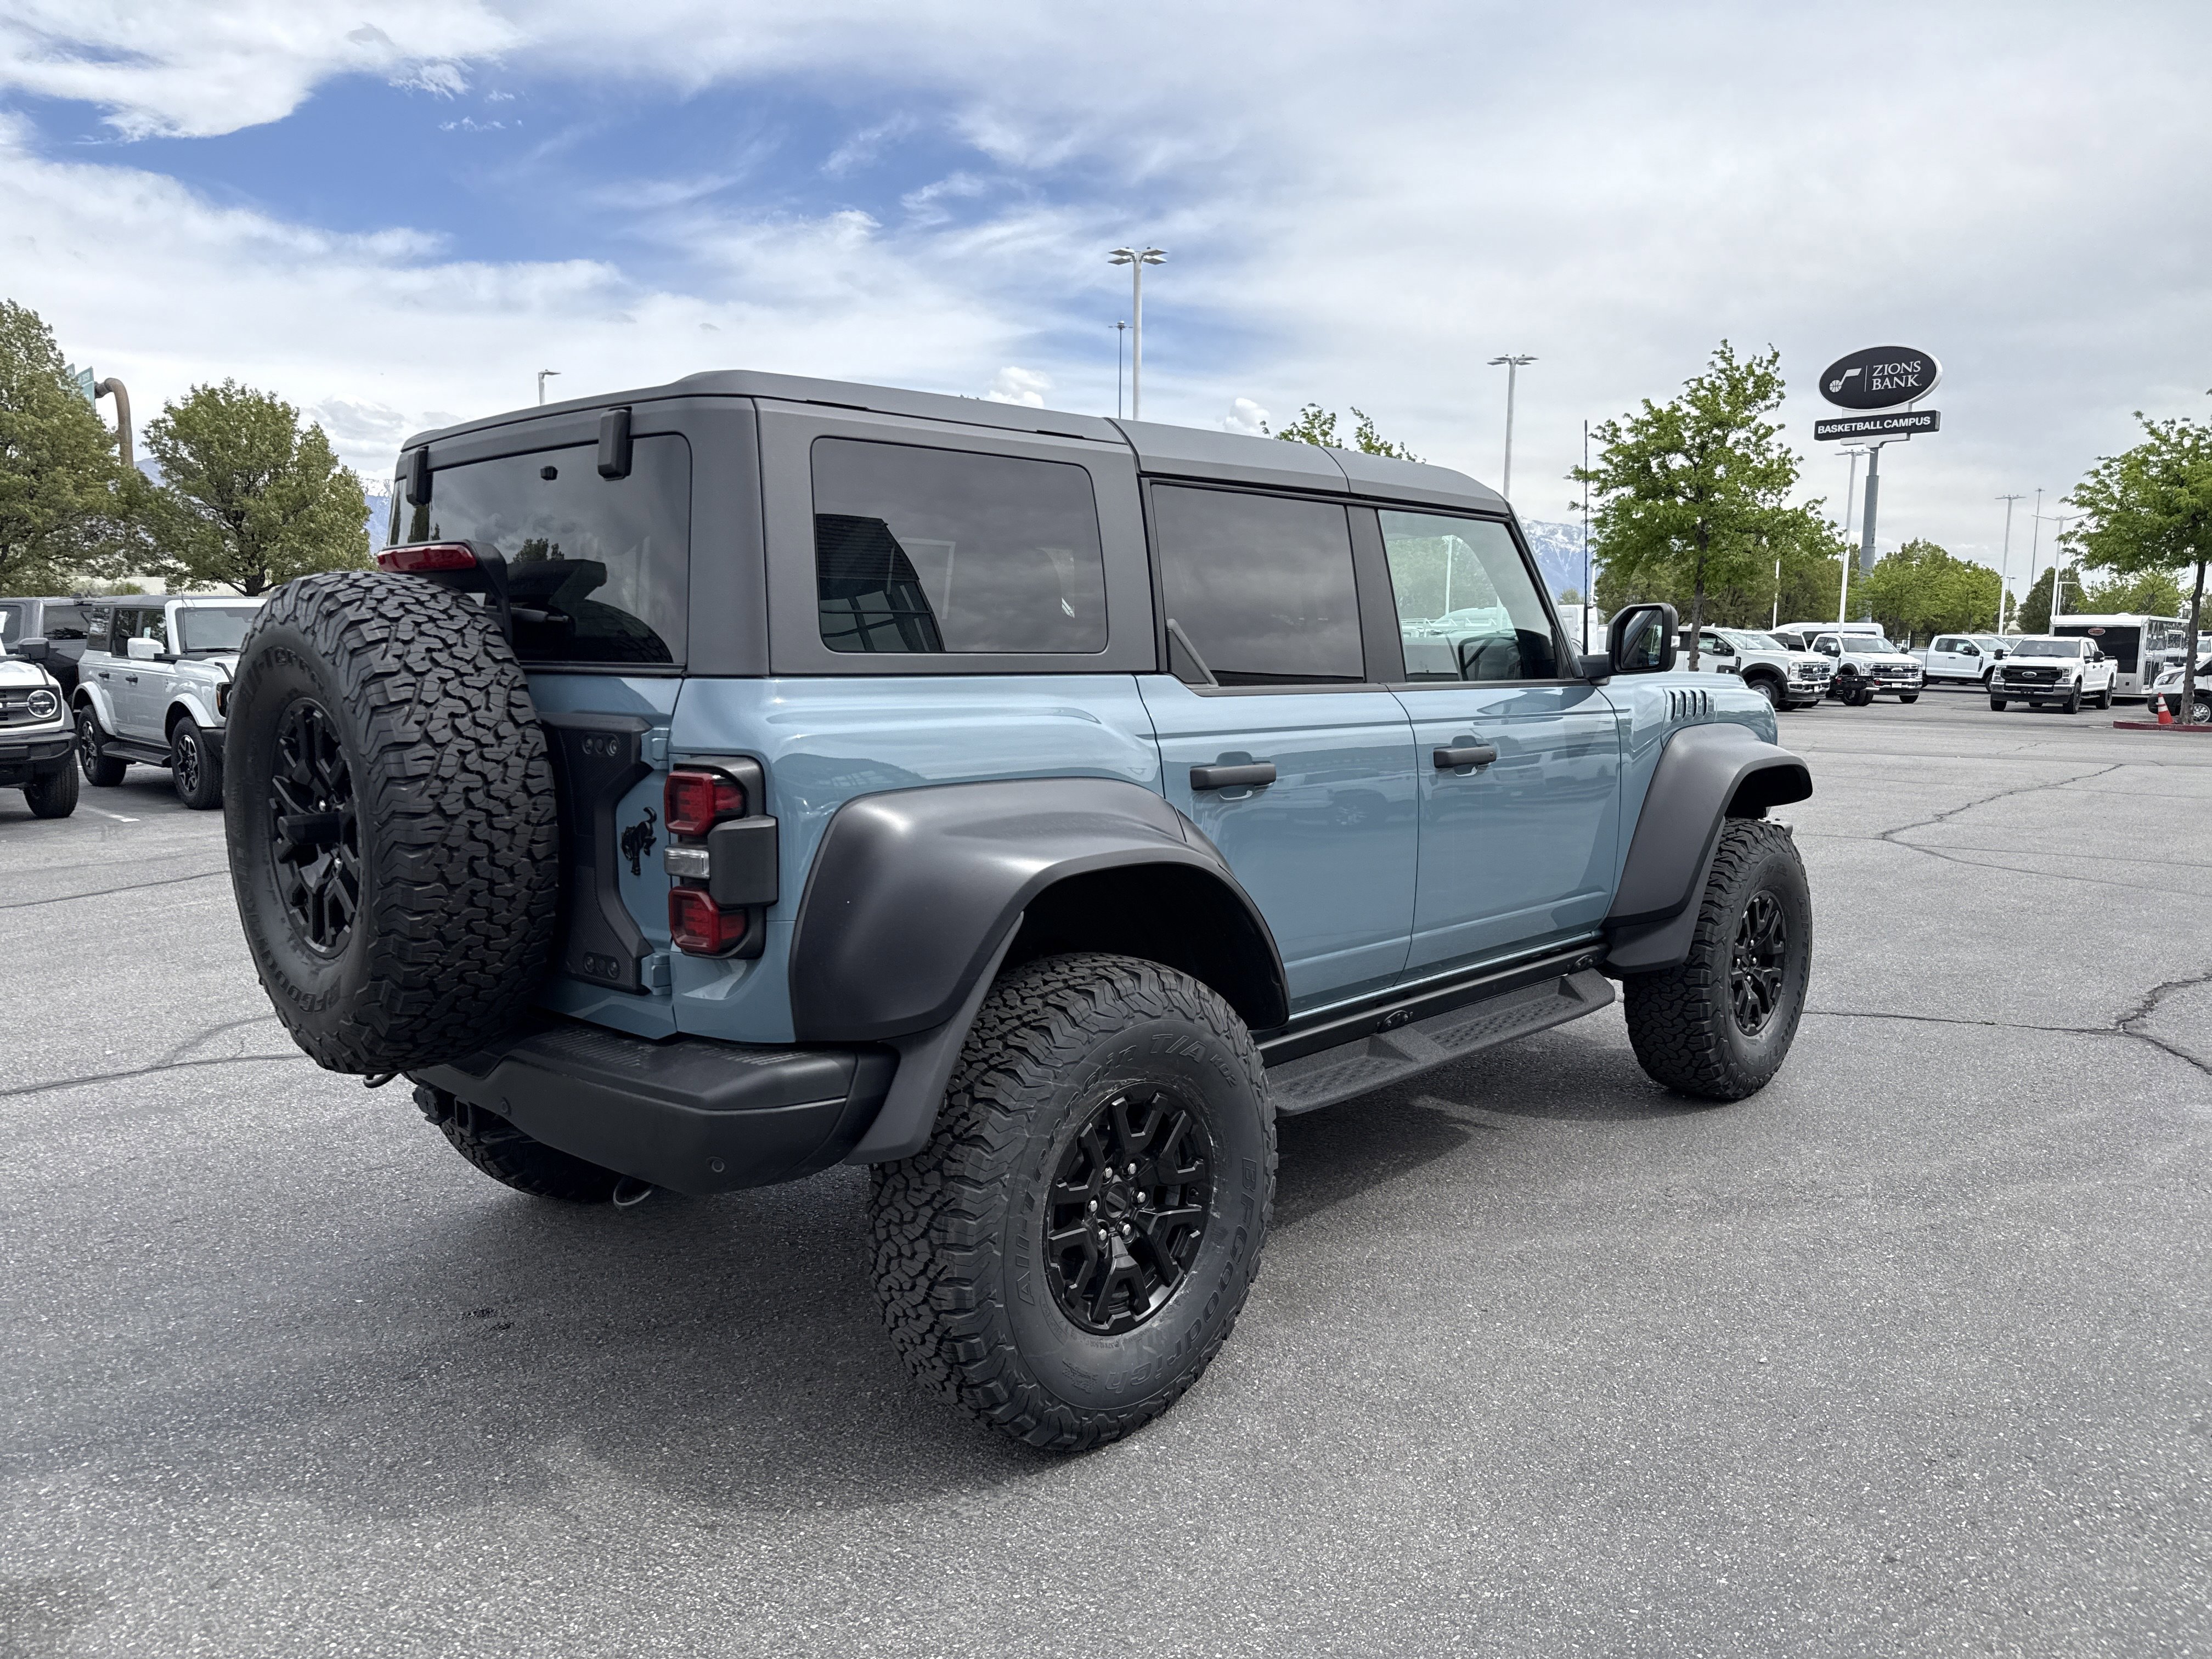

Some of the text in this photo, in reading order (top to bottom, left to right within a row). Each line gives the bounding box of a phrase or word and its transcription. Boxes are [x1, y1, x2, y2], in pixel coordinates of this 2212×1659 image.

[1872, 360, 1921, 376] ZIONS
[1818, 416, 1931, 434] BASKETBALL CAMPUS
[1150, 1034, 1207, 1063] T/A
[1105, 1157, 1257, 1394] BFGoodrich
